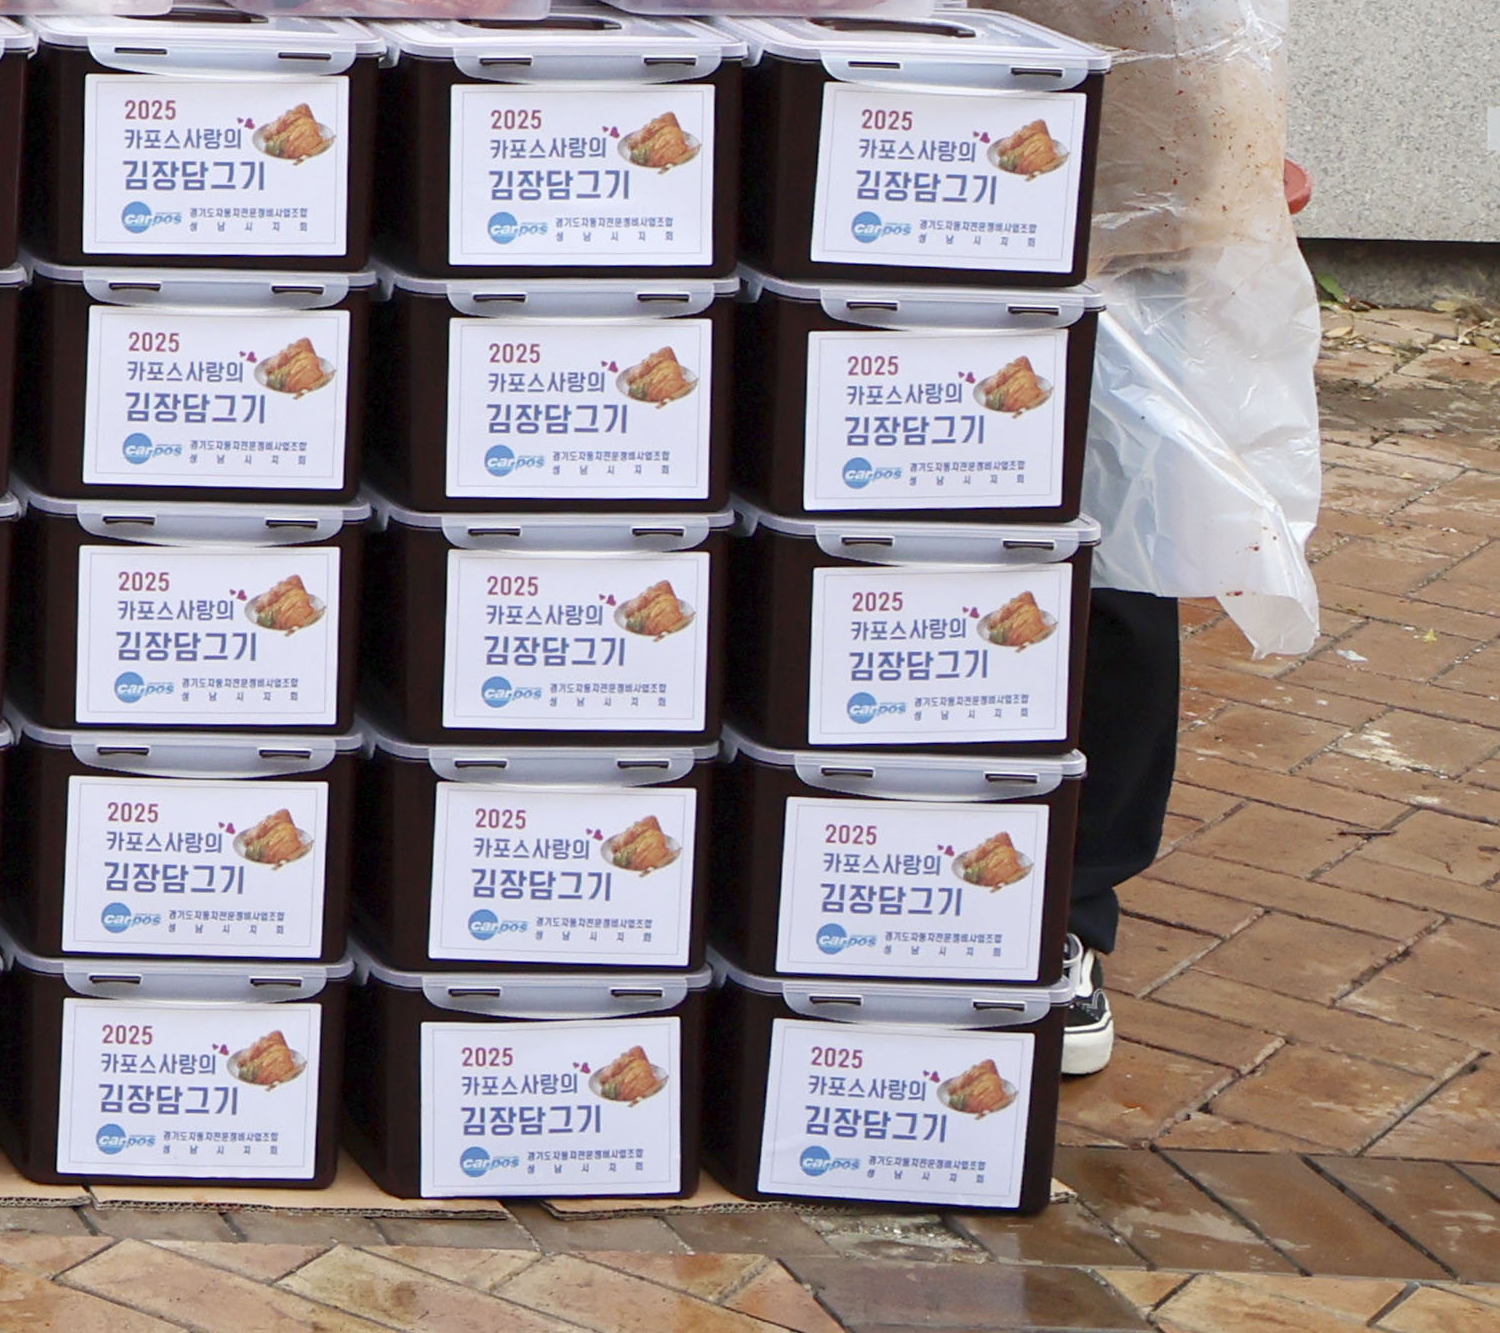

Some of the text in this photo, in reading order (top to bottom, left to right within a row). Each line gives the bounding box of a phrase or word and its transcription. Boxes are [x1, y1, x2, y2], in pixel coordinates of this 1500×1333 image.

[124, 99, 176, 120] 2025
[860, 109, 914, 131] 2025
[124, 128, 242, 150] 카포스사랑의
[858, 137, 977, 163] 카포스사랑의
[123, 160, 266, 191] 김장담그기
[854, 169, 998, 205] 김장담그기
[488, 343, 541, 364] 2025
[488, 372, 606, 393] 카포스사랑의
[486, 403, 629, 434] 김장담그기
[851, 591, 903, 612] 2025
[851, 618, 967, 642] 카포스사랑의
[849, 648, 989, 682] 김장담그기
[474, 808, 527, 830] 2025
[473, 837, 591, 861] 카포스사랑의
[471, 868, 613, 902] 김장담그기
[810, 1046, 864, 1069] 2025
[807, 1074, 927, 1102] 카포스사랑의
[803, 1105, 948, 1143] 김장담그기
